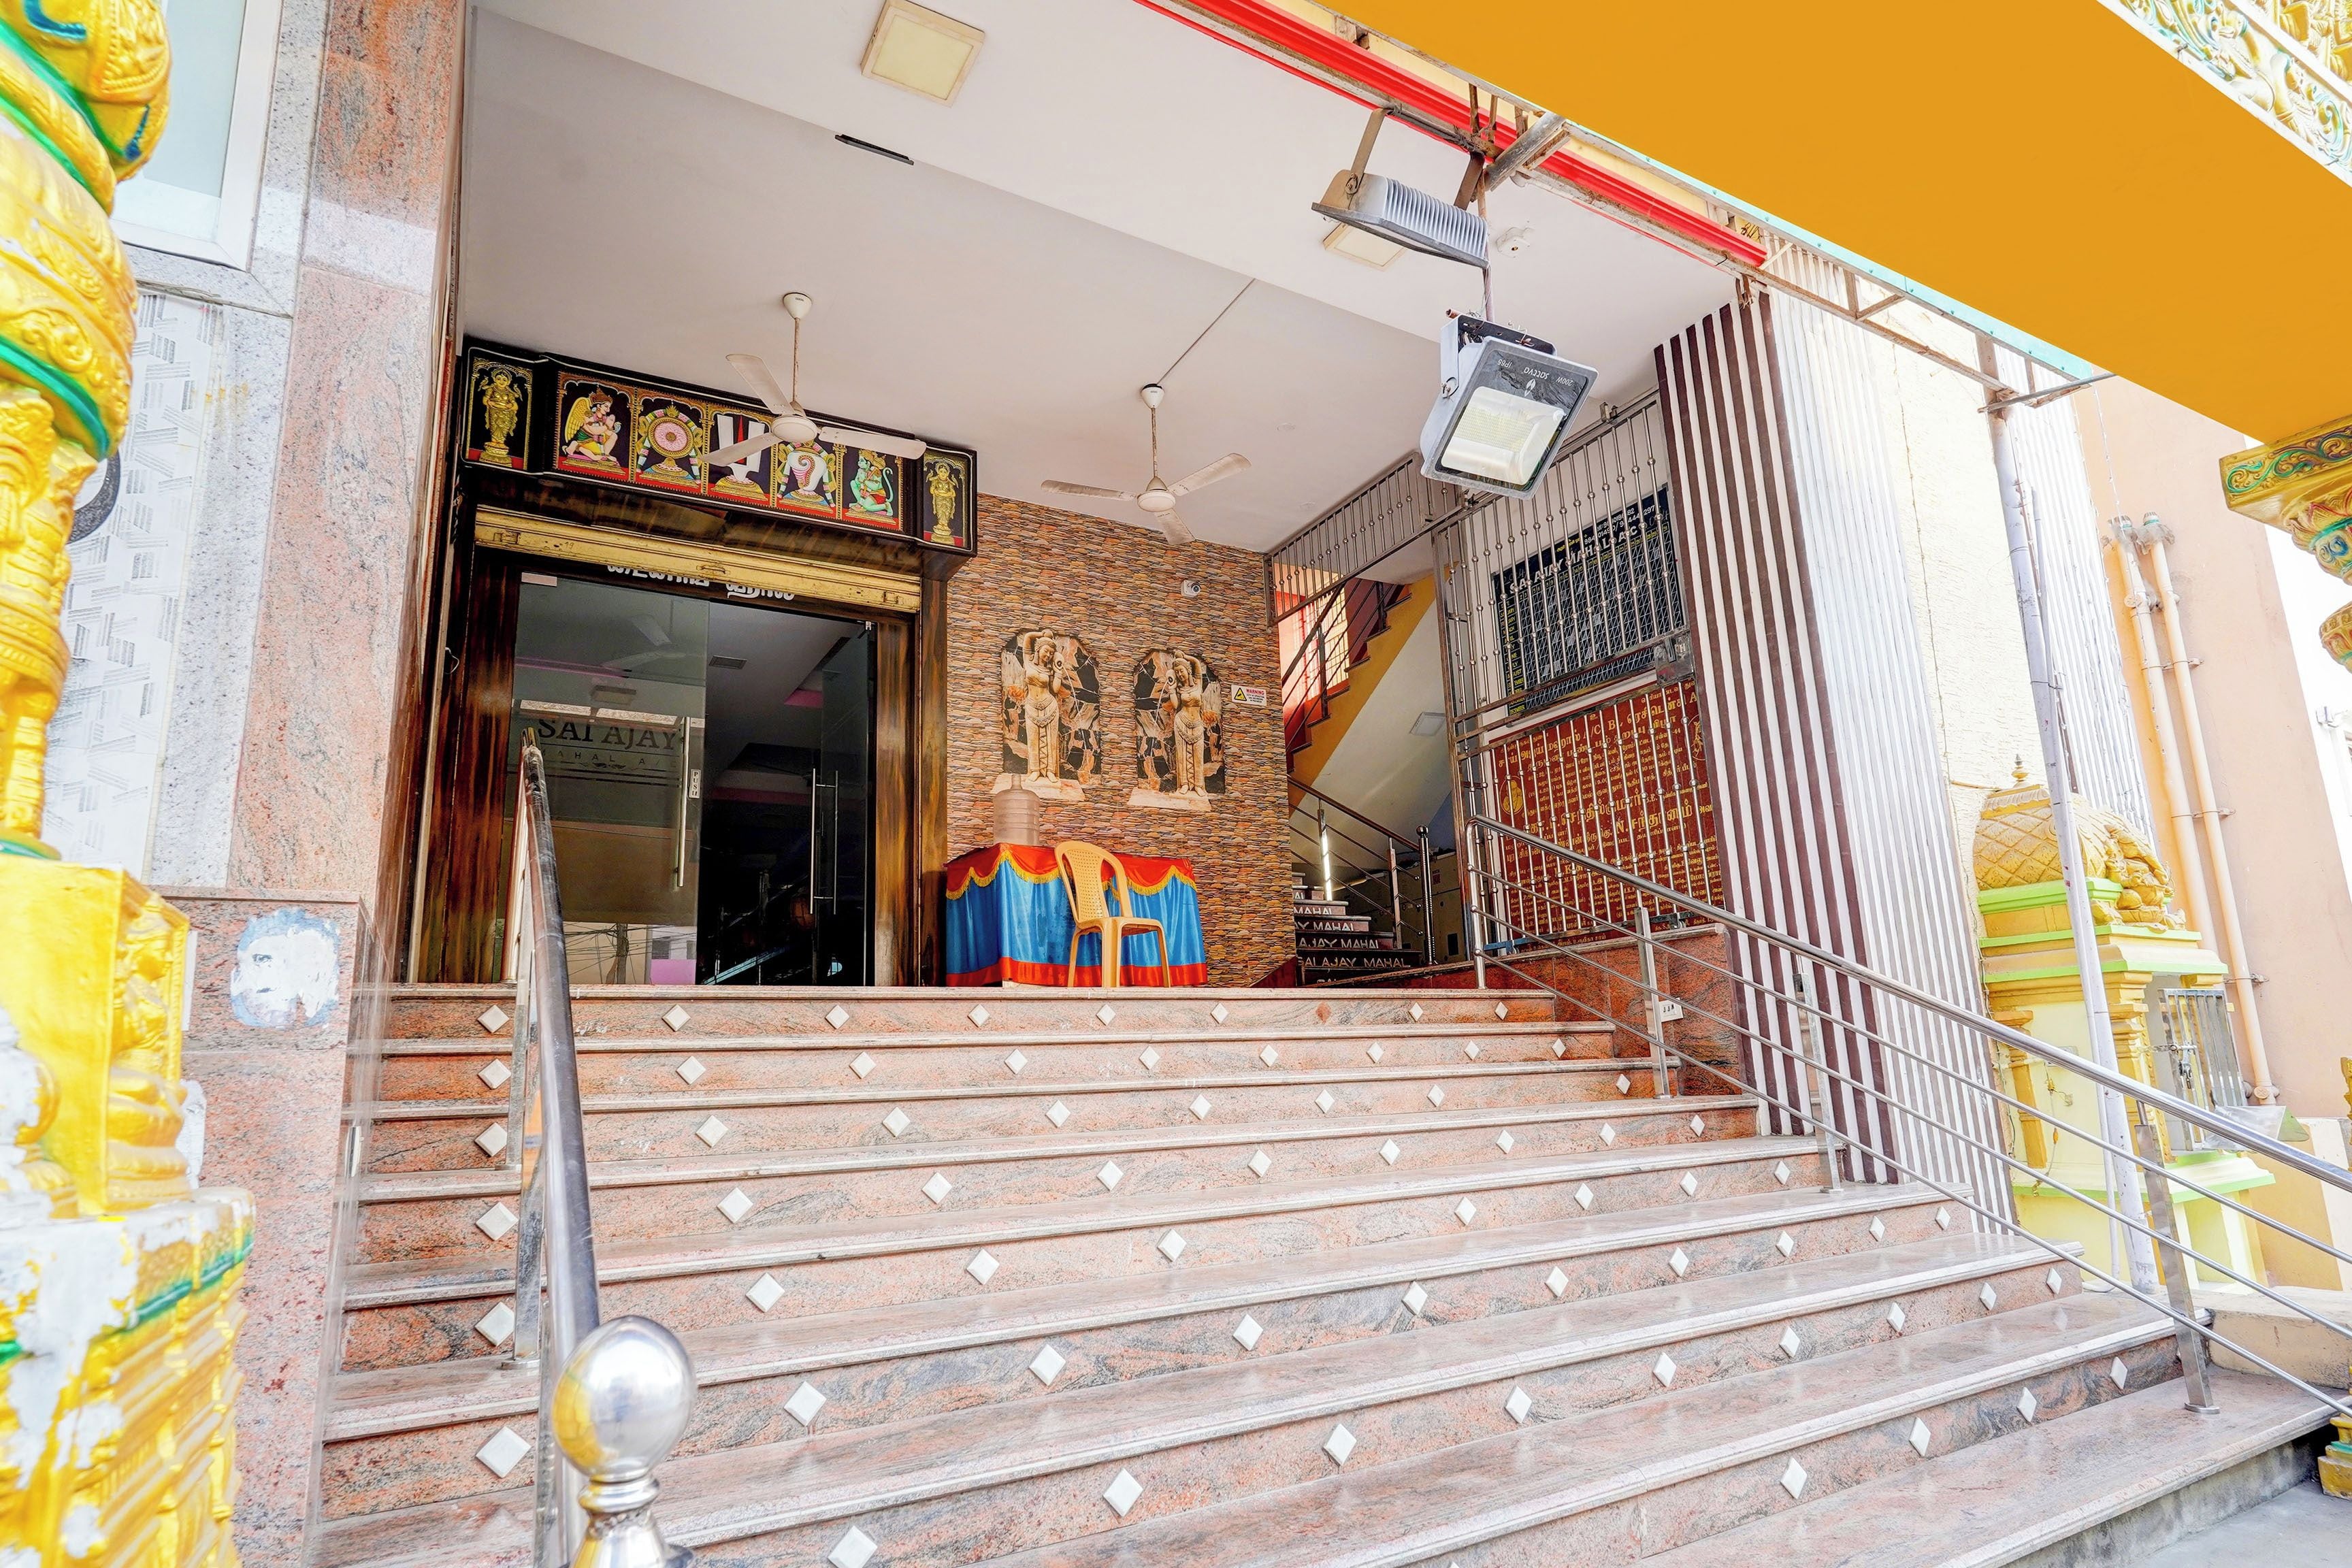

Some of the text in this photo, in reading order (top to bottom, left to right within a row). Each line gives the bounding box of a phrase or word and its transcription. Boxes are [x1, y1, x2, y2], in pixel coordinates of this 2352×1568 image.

[1556, 376, 1573, 387] 200W
[538, 718, 676, 750] SAI AJAY
[1322, 957, 1357, 968] AJAY
[1364, 958, 1411, 968] MAHAL
